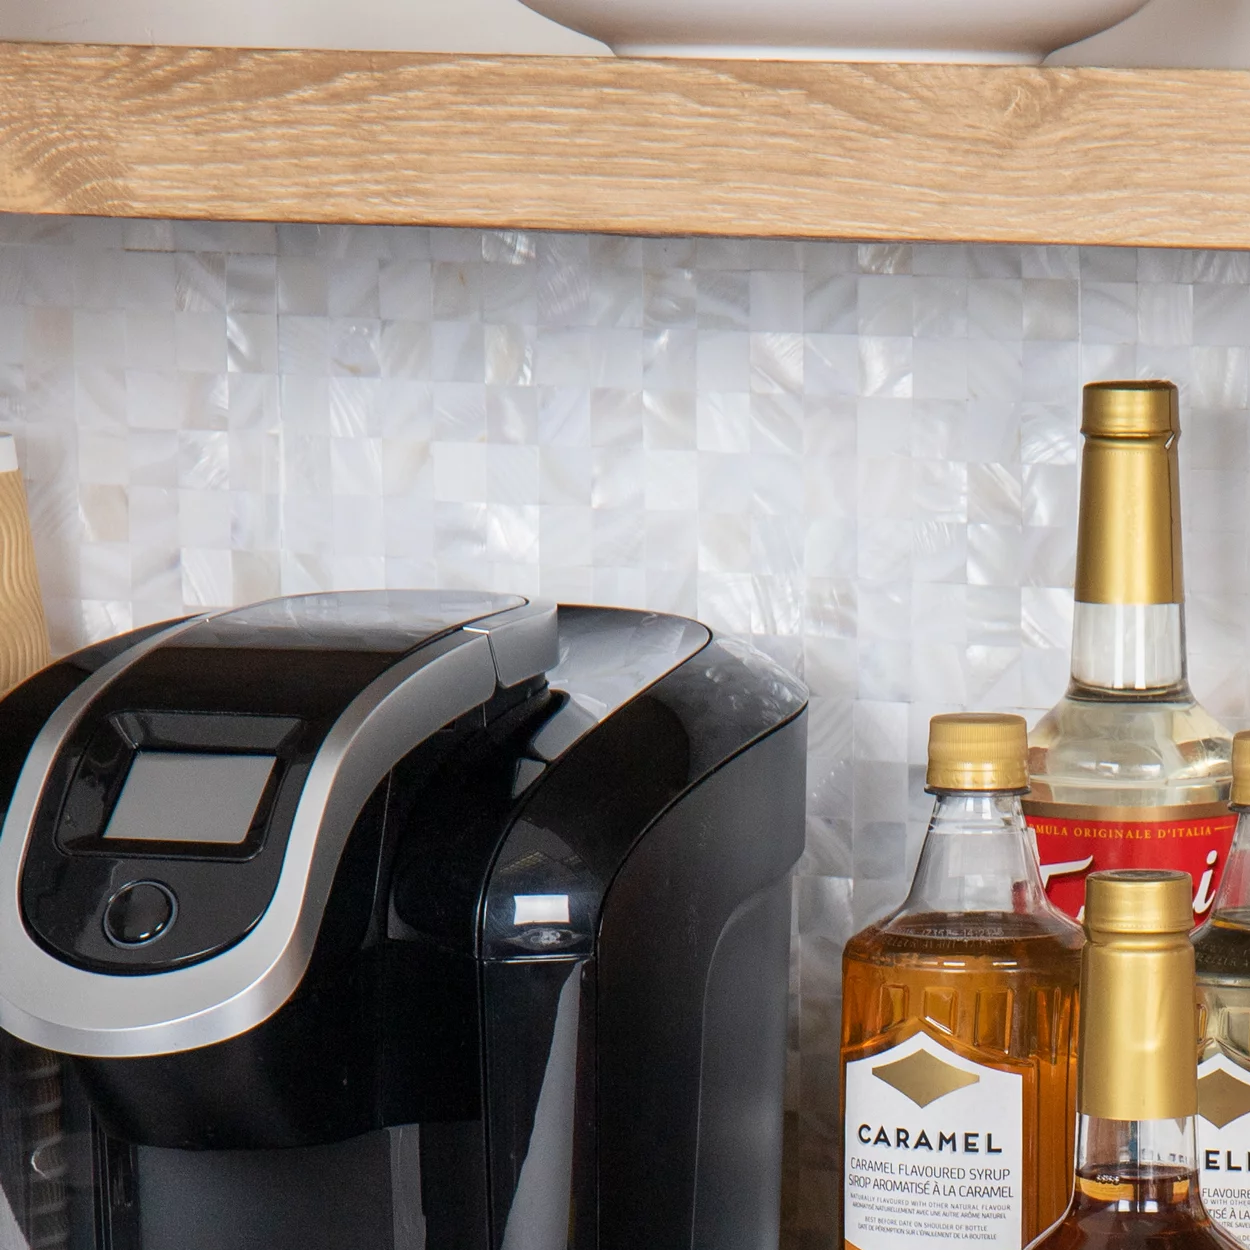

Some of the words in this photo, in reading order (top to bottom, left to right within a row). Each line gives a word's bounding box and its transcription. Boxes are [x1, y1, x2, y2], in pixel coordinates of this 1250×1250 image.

[1029, 824, 1068, 836] MULA
[1073, 827, 1152, 839] ORIGINALE
[1157, 826, 1212, 839] D'ITALIA
[857, 1123, 1003, 1153] CARAMEL
[850, 1157, 895, 1175] CARAMEL
[898, 1163, 966, 1180] FLAVOURED
[969, 1168, 1011, 1181] SYRUP
[848, 1173, 871, 1189] SIROP
[872, 1178, 930, 1195] AROMATISÉ
[932, 1180, 941, 1196] À
[943, 1184, 957, 1197] LA
[958, 1185, 1014, 1198] CARAMEL
[850, 1193, 876, 1202] NATURALLY
[876, 1197, 910, 1206] FLAVOURED
[910, 1200, 927, 1208] WITH
[928, 1201, 949, 1209] OTHER
[950, 1203, 979, 1211] NATURAL
[981, 1212, 1007, 1220] NATUREL
[1229, 1207, 1237, 1219] À
[1239, 1210, 1250, 1220] LA
[857, 1222, 868, 1231] DATE
[864, 1215, 877, 1223] BEST
[877, 1217, 897, 1226] BEFORE
[898, 1219, 912, 1227] DATE
[923, 1222, 954, 1230] SHOULDER
